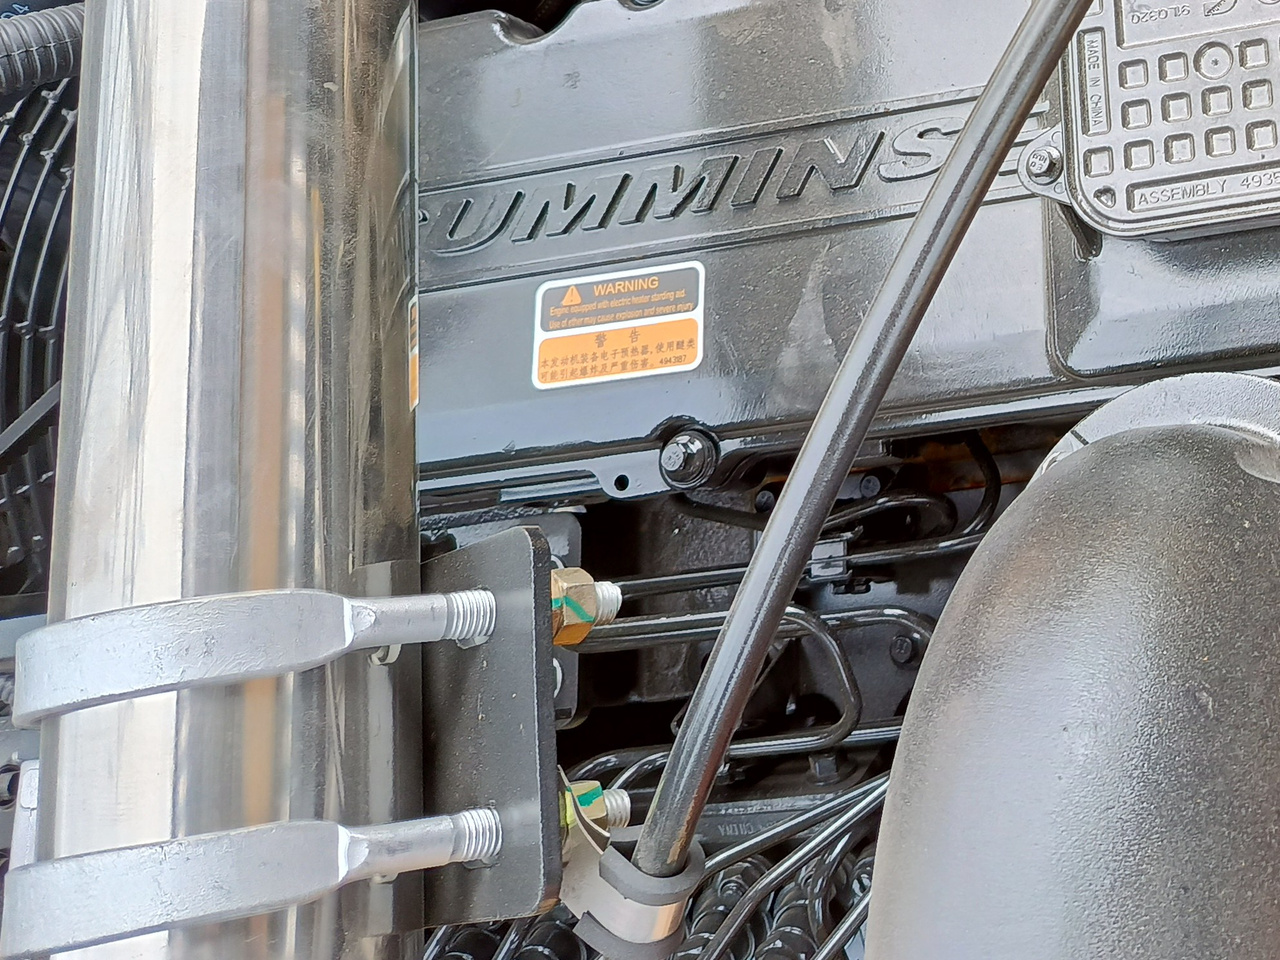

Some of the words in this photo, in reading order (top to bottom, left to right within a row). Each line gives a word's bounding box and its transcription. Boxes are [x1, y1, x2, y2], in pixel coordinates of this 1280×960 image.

[1086, 38, 1100, 71] MADE
[1090, 76, 1099, 86] IN
[1090, 93, 1104, 128] CHINA
[419, 116, 968, 258] UMMINS
[1137, 178, 1228, 207] ASSEMBLY
[593, 276, 660, 297] WARNING
